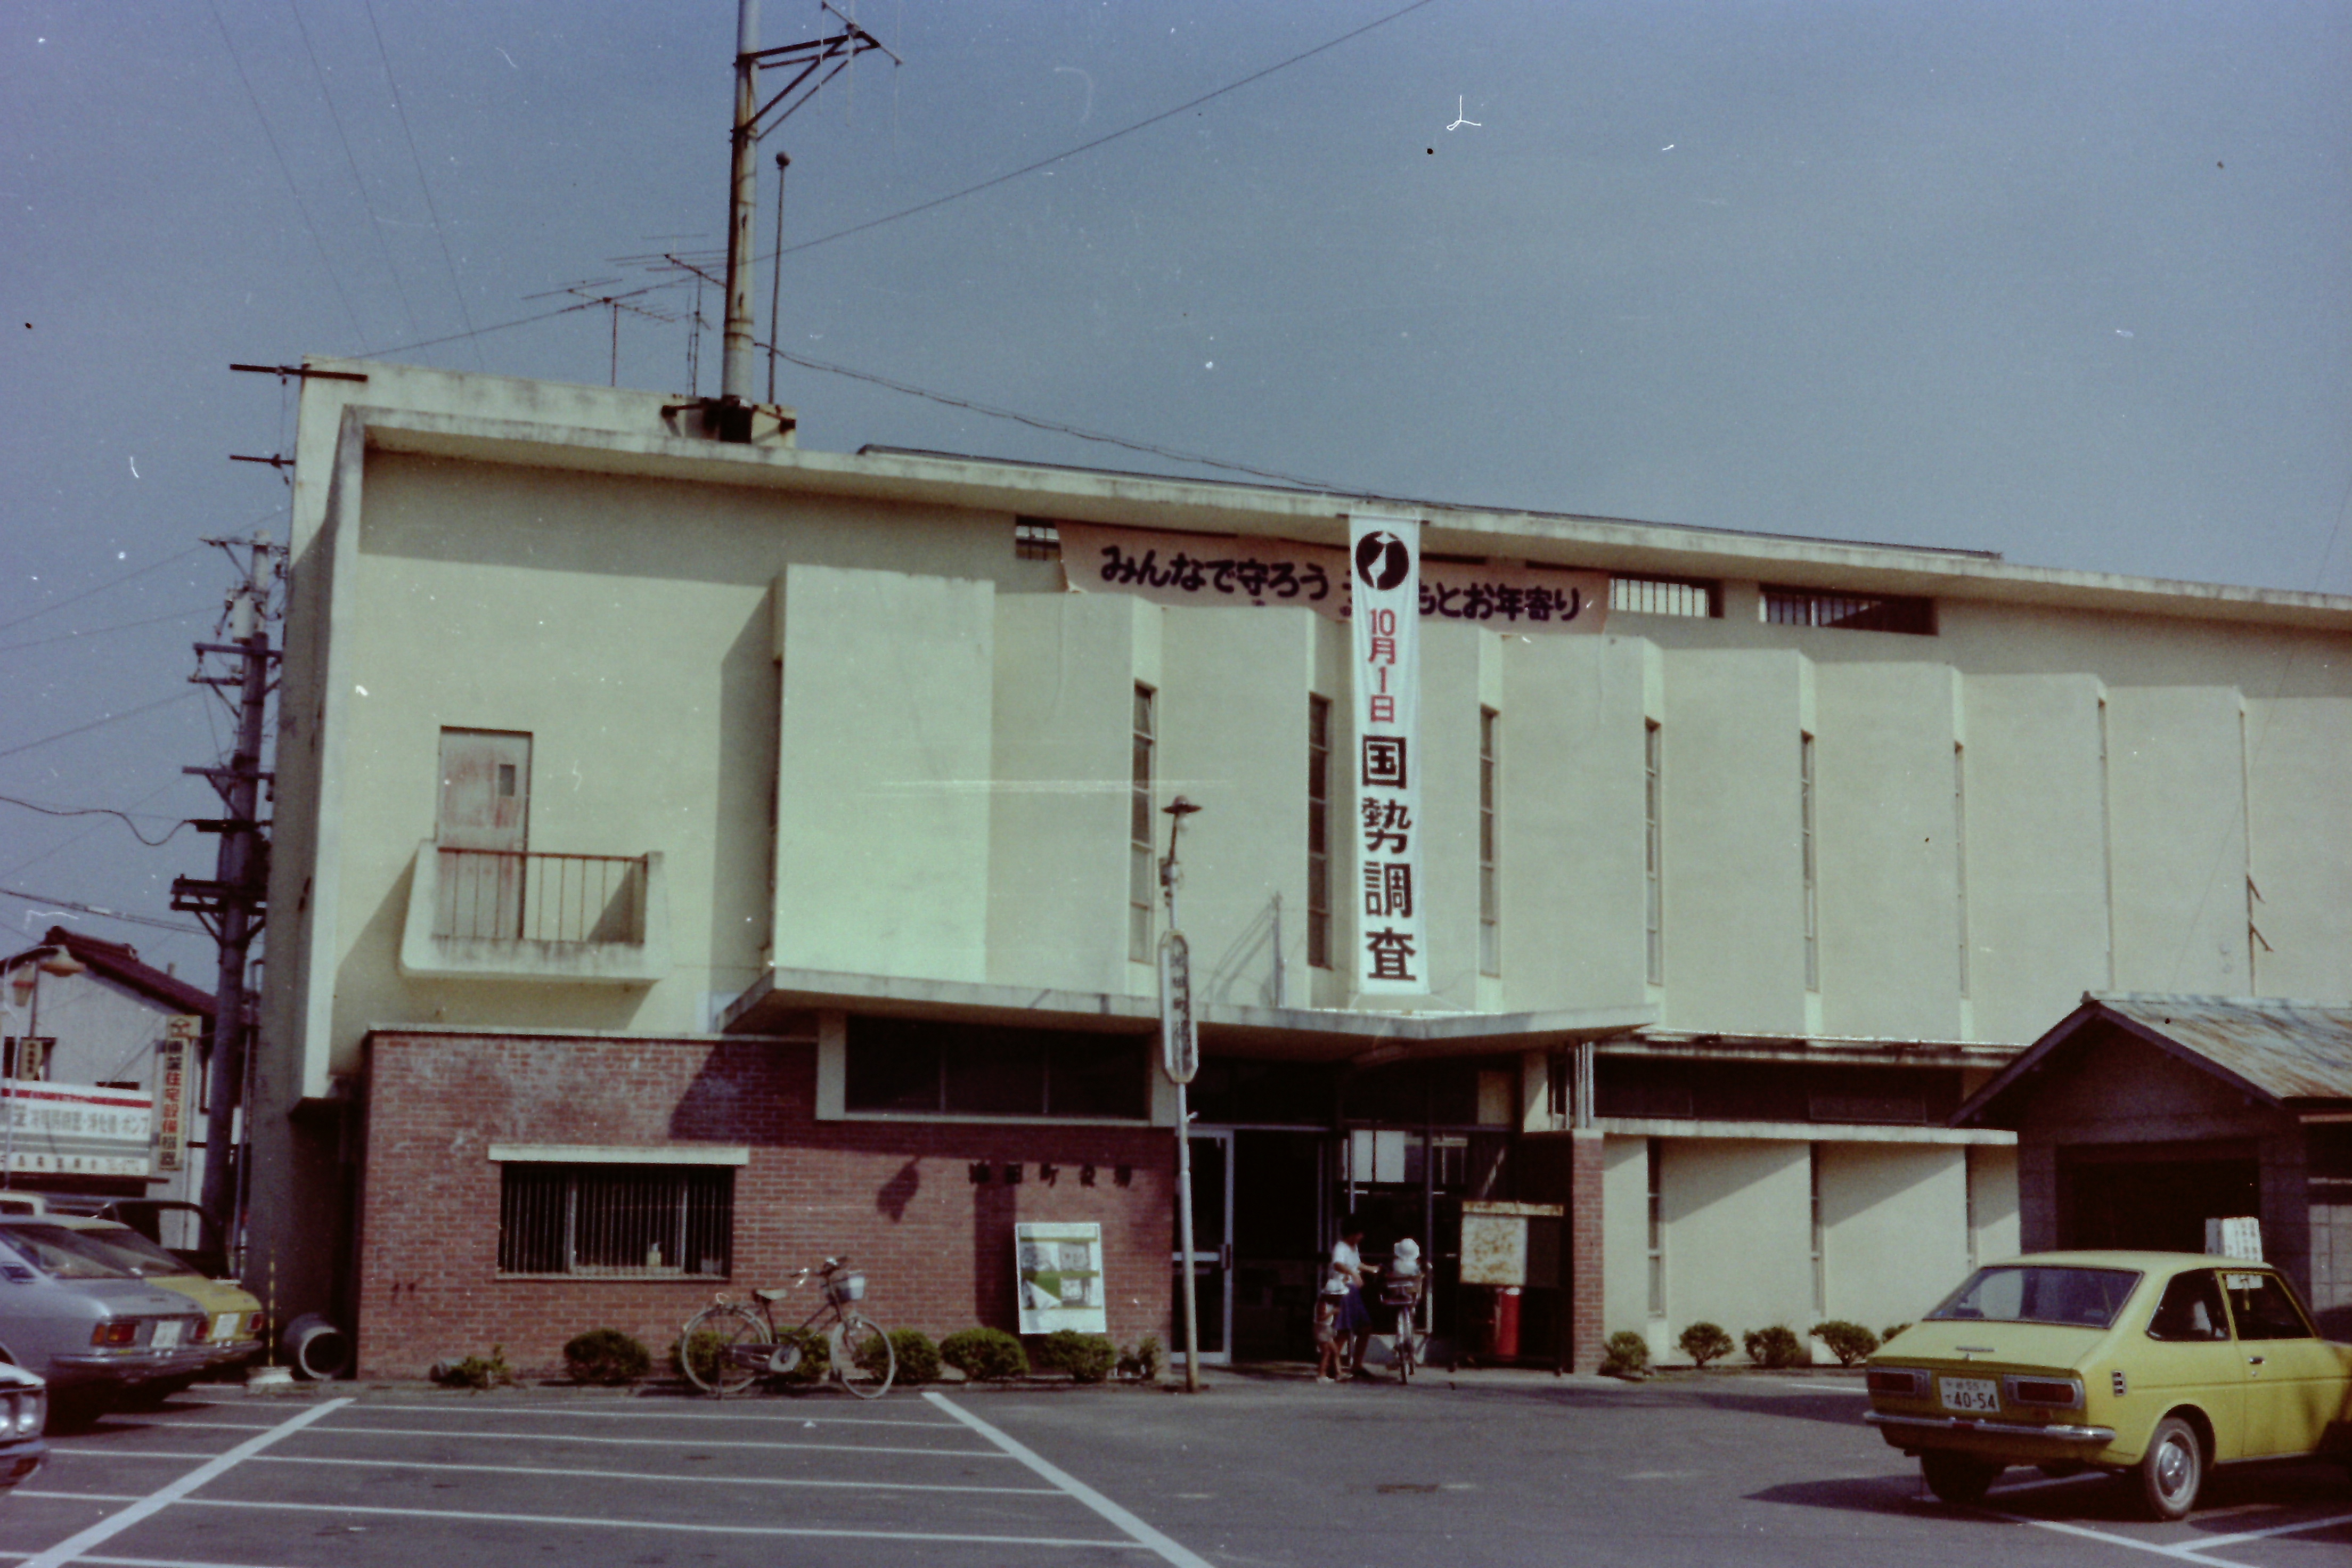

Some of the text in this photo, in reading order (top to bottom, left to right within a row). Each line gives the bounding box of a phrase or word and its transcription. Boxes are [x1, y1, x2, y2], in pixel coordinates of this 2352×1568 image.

[1101, 545, 1329, 601] みんなで守ろう
[1361, 608, 1417, 982] 10月1日 国勢調査
[1955, 1391, 1996, 1409] 40-54
